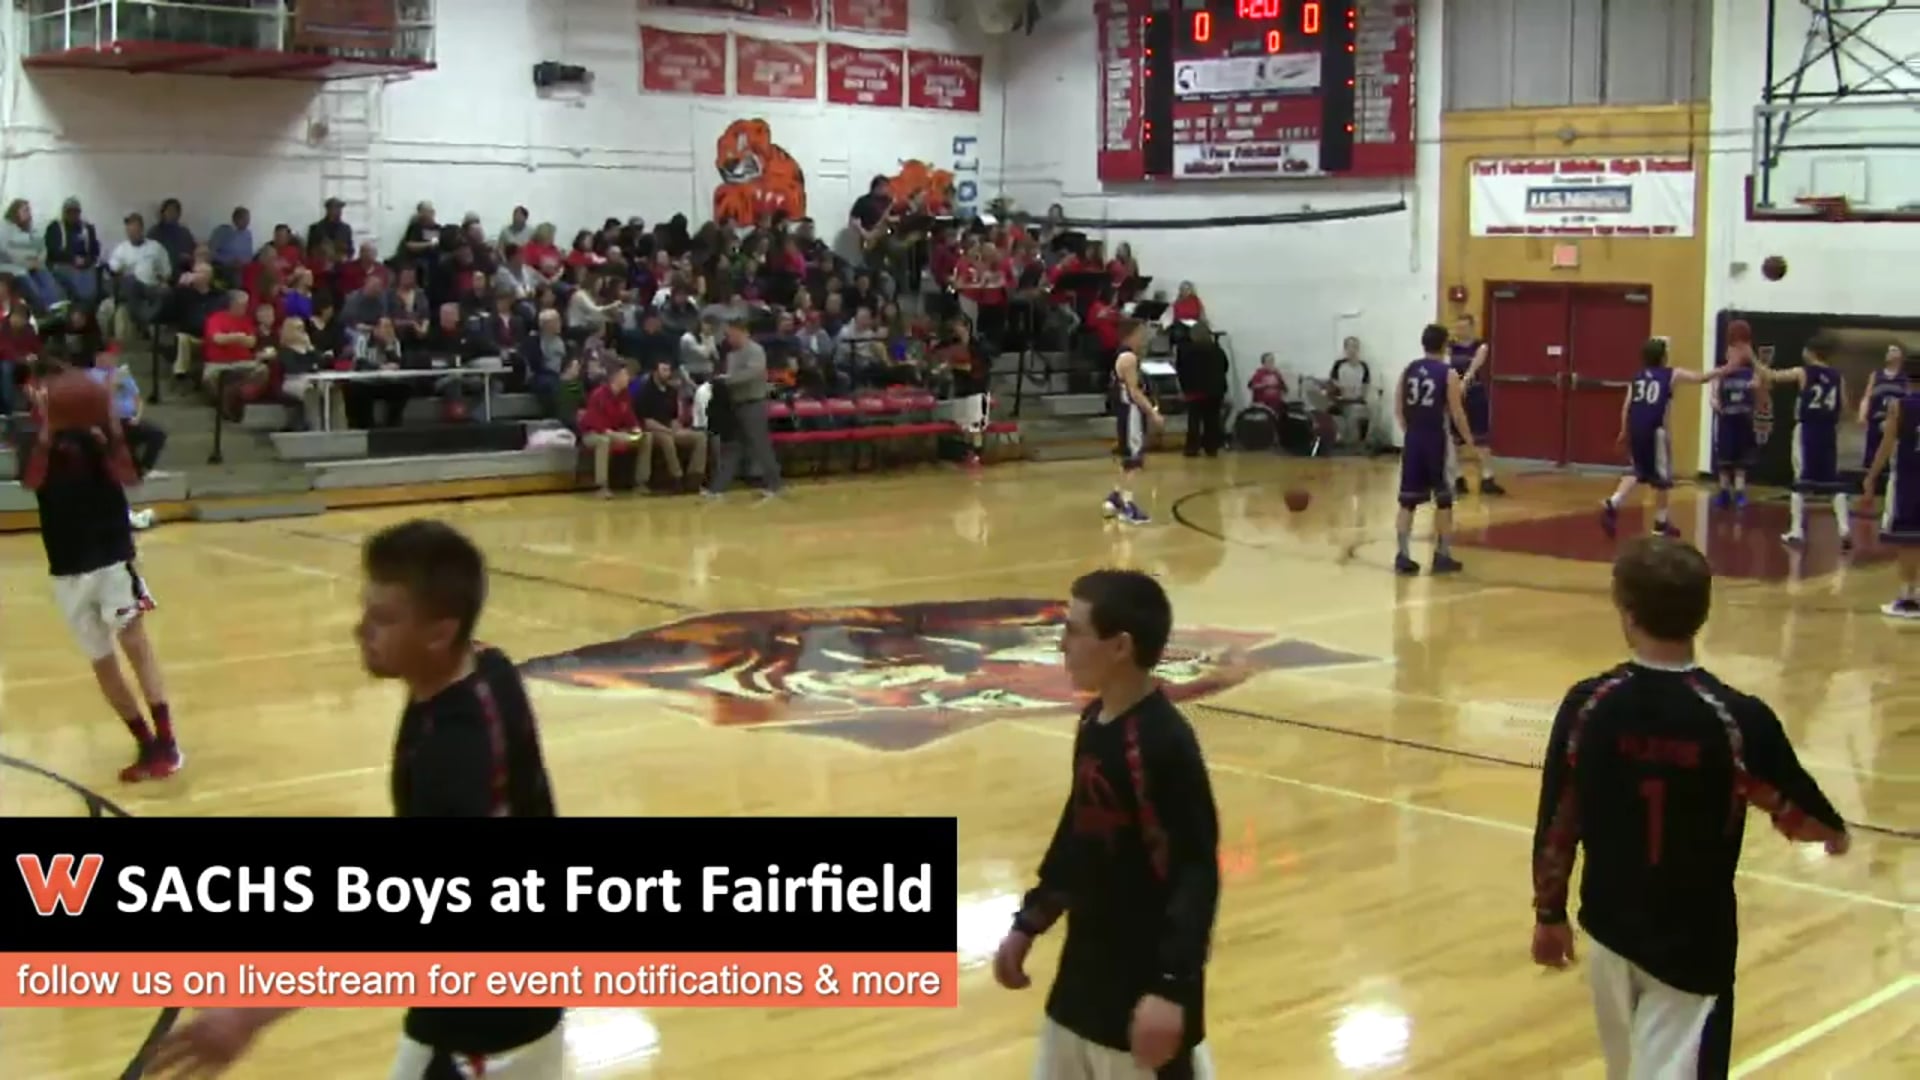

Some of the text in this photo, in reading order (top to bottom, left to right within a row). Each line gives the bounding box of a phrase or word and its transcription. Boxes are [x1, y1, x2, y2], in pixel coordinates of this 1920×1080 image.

[1194, 12, 1210, 42] 0
[1303, 3, 1319, 34] 0
[1267, 30, 1281, 53] 0
[1406, 377, 1436, 408] 32
[1633, 378, 1661, 404] 30
[1808, 383, 1838, 411] 24
[1639, 777, 1665, 867] 1
